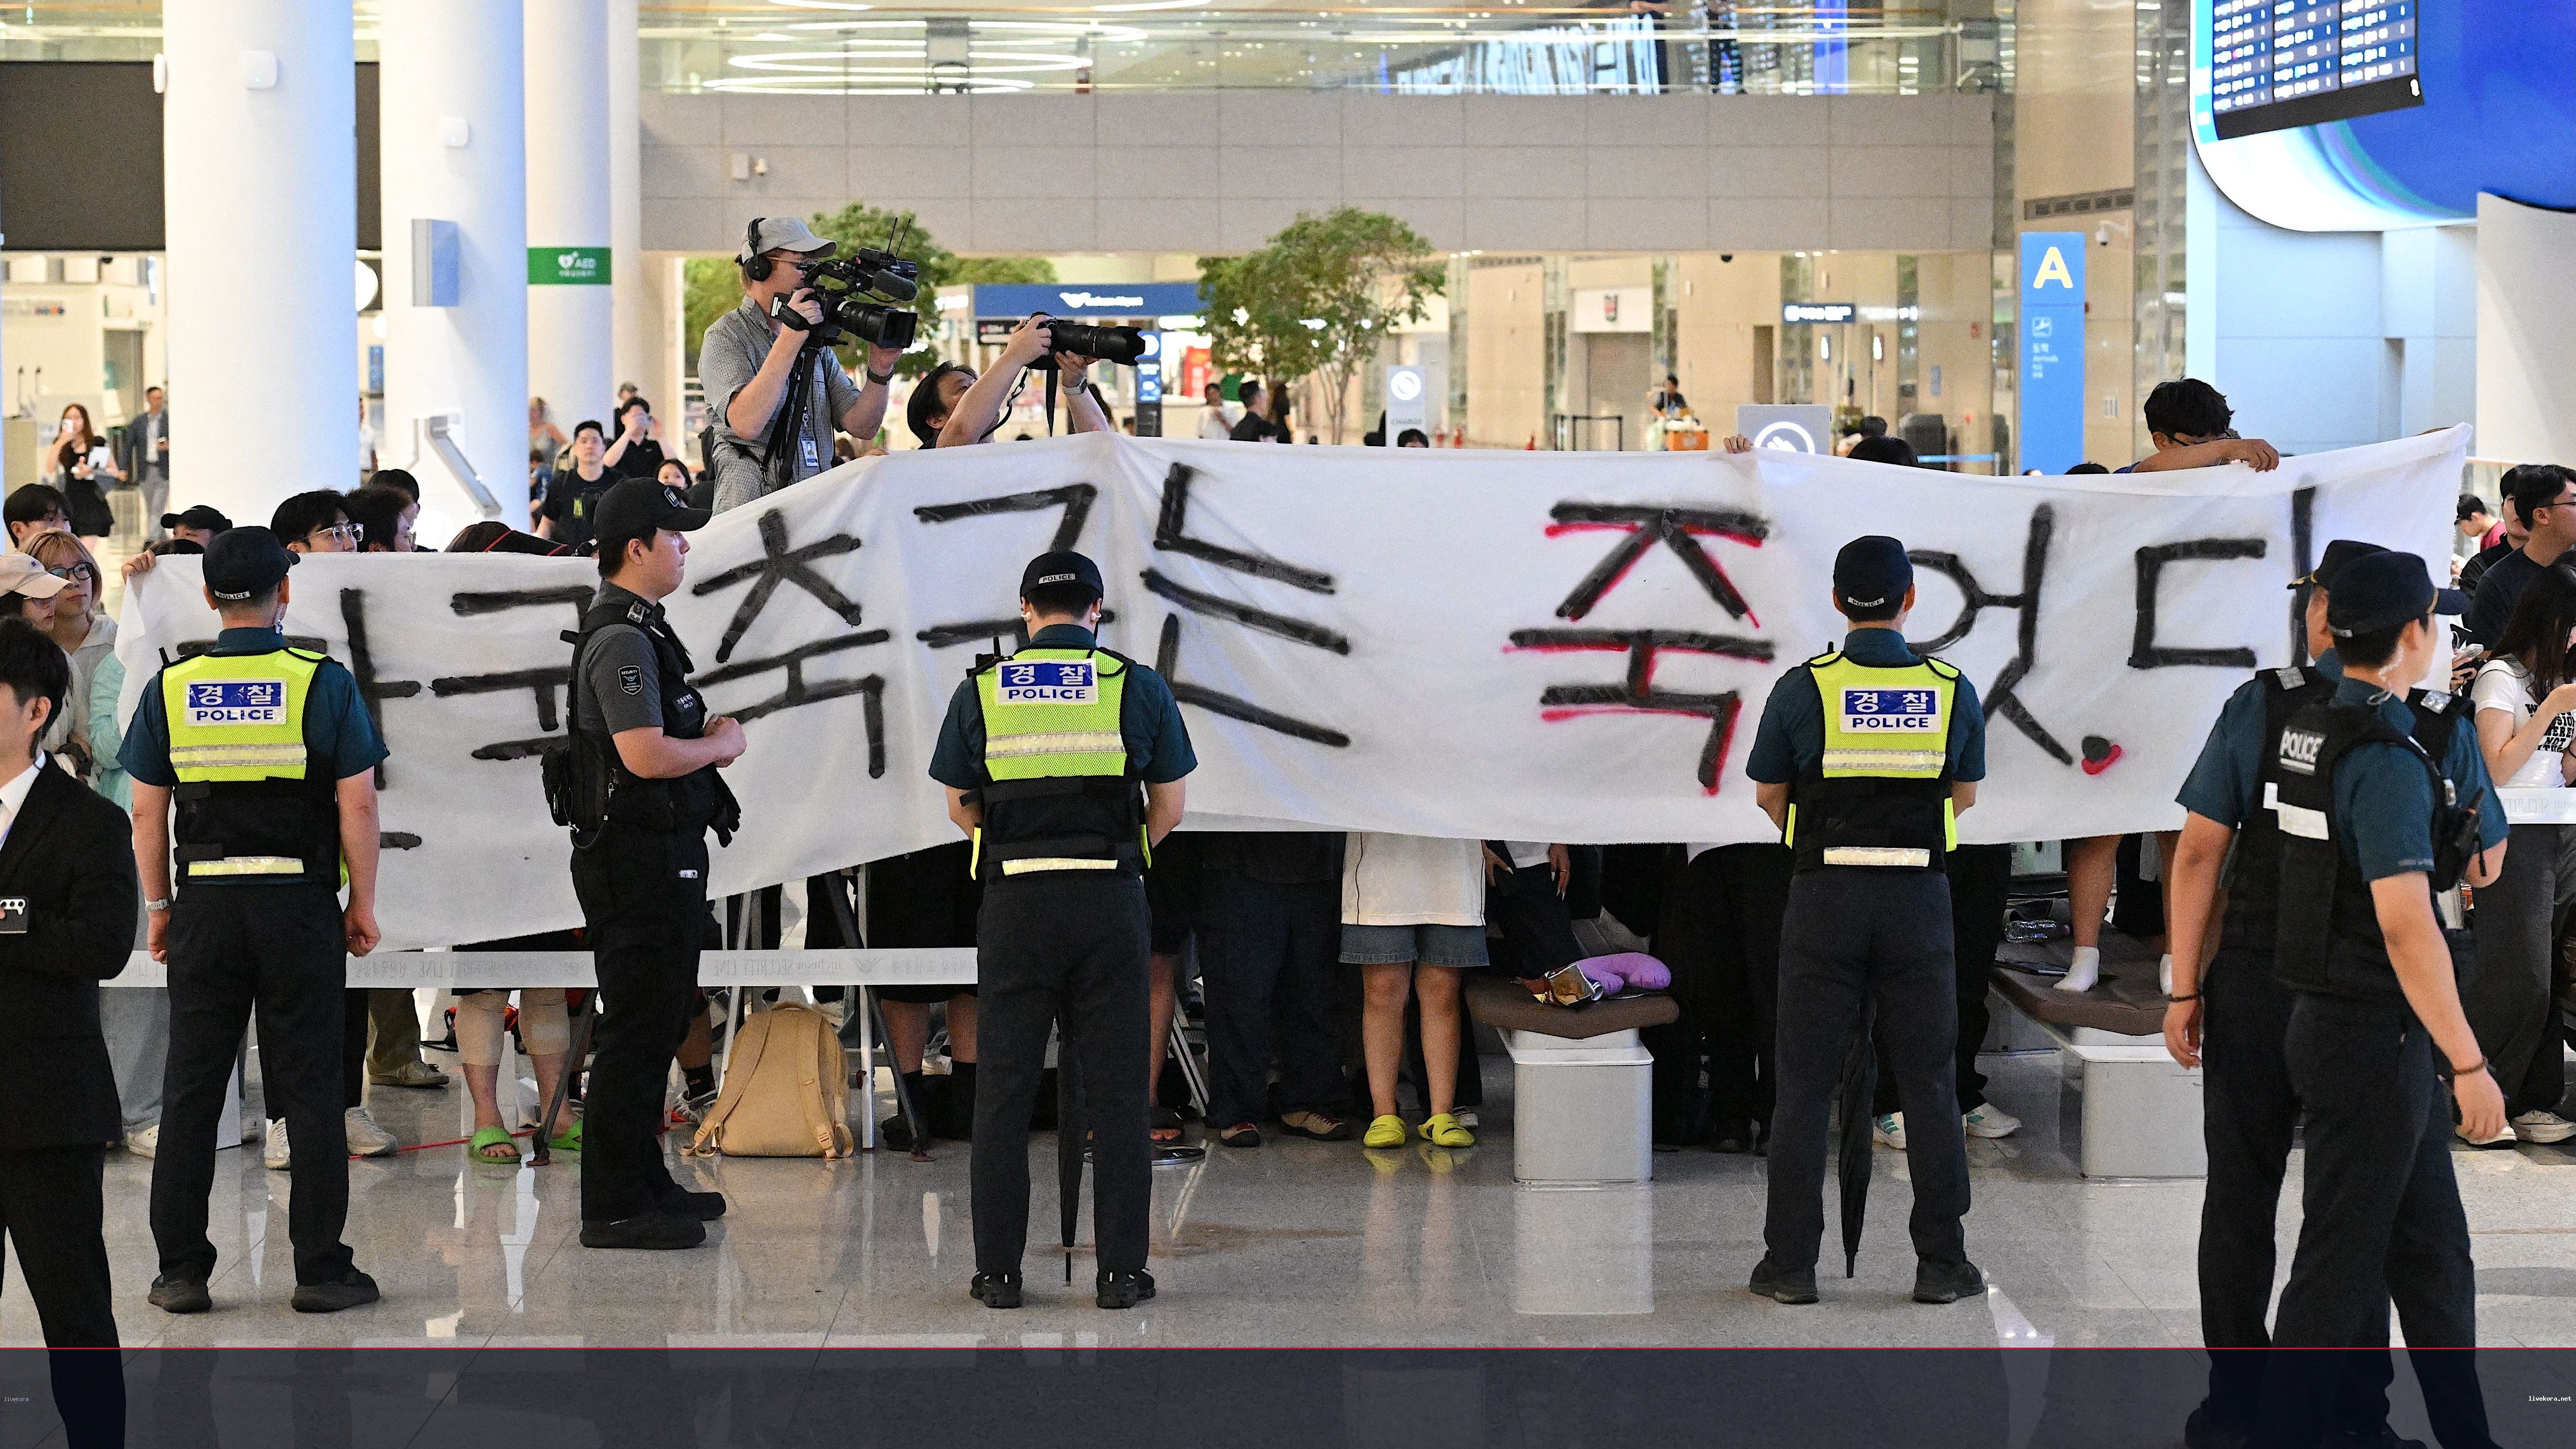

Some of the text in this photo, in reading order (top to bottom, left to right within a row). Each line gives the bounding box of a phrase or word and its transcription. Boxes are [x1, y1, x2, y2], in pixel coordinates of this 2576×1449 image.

[2033, 246, 2073, 289] A
[1009, 688, 1086, 699] POLICE
[197, 710, 273, 721] POLICE
[1852, 717, 1929, 728] POLICE
[2279, 730, 2323, 763] POLICE
